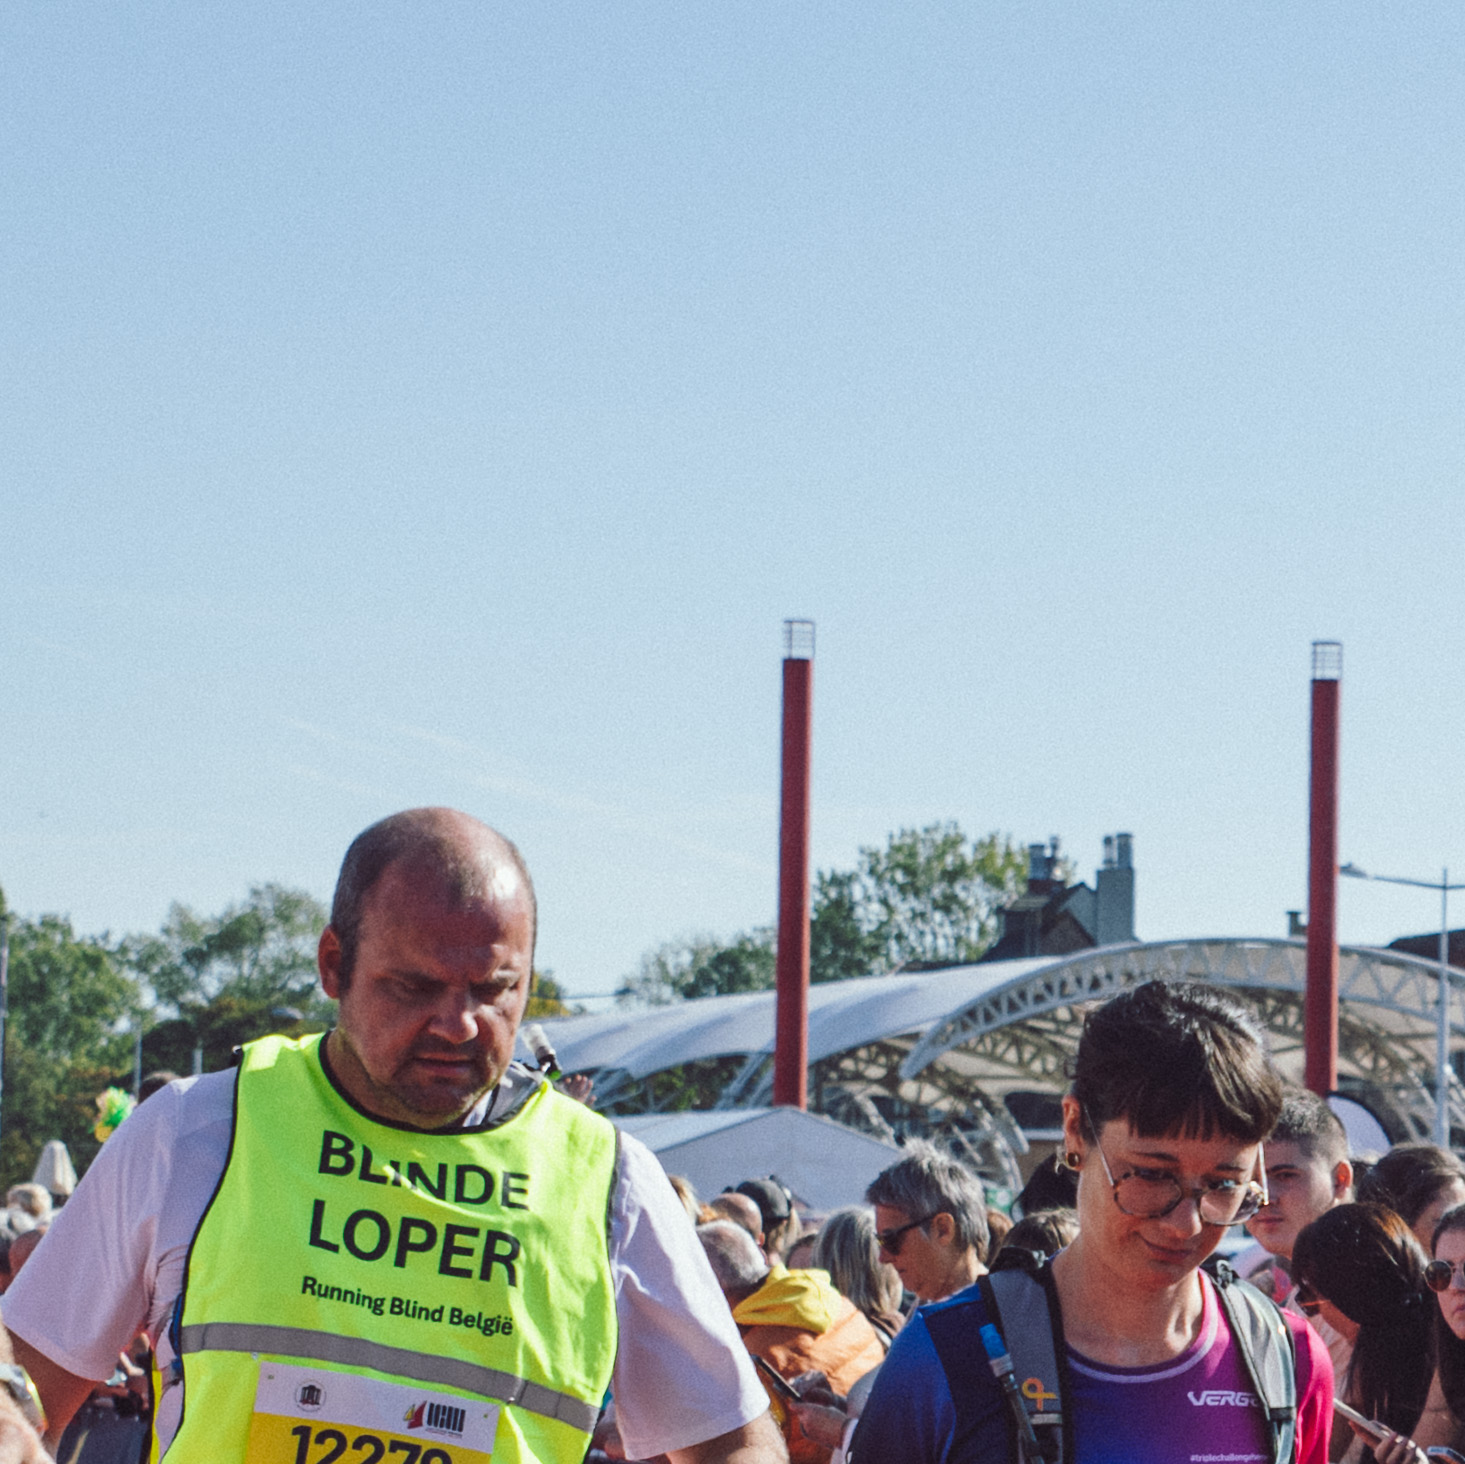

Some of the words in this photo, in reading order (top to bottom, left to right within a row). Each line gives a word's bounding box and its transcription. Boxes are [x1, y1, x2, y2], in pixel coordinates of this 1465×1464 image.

[318, 1130, 530, 1210] BLINDE
[309, 1199, 521, 1287] LOPER
[301, 1276, 386, 1316] Running
[389, 1297, 445, 1323] Blind
[449, 1308, 513, 1336] België
